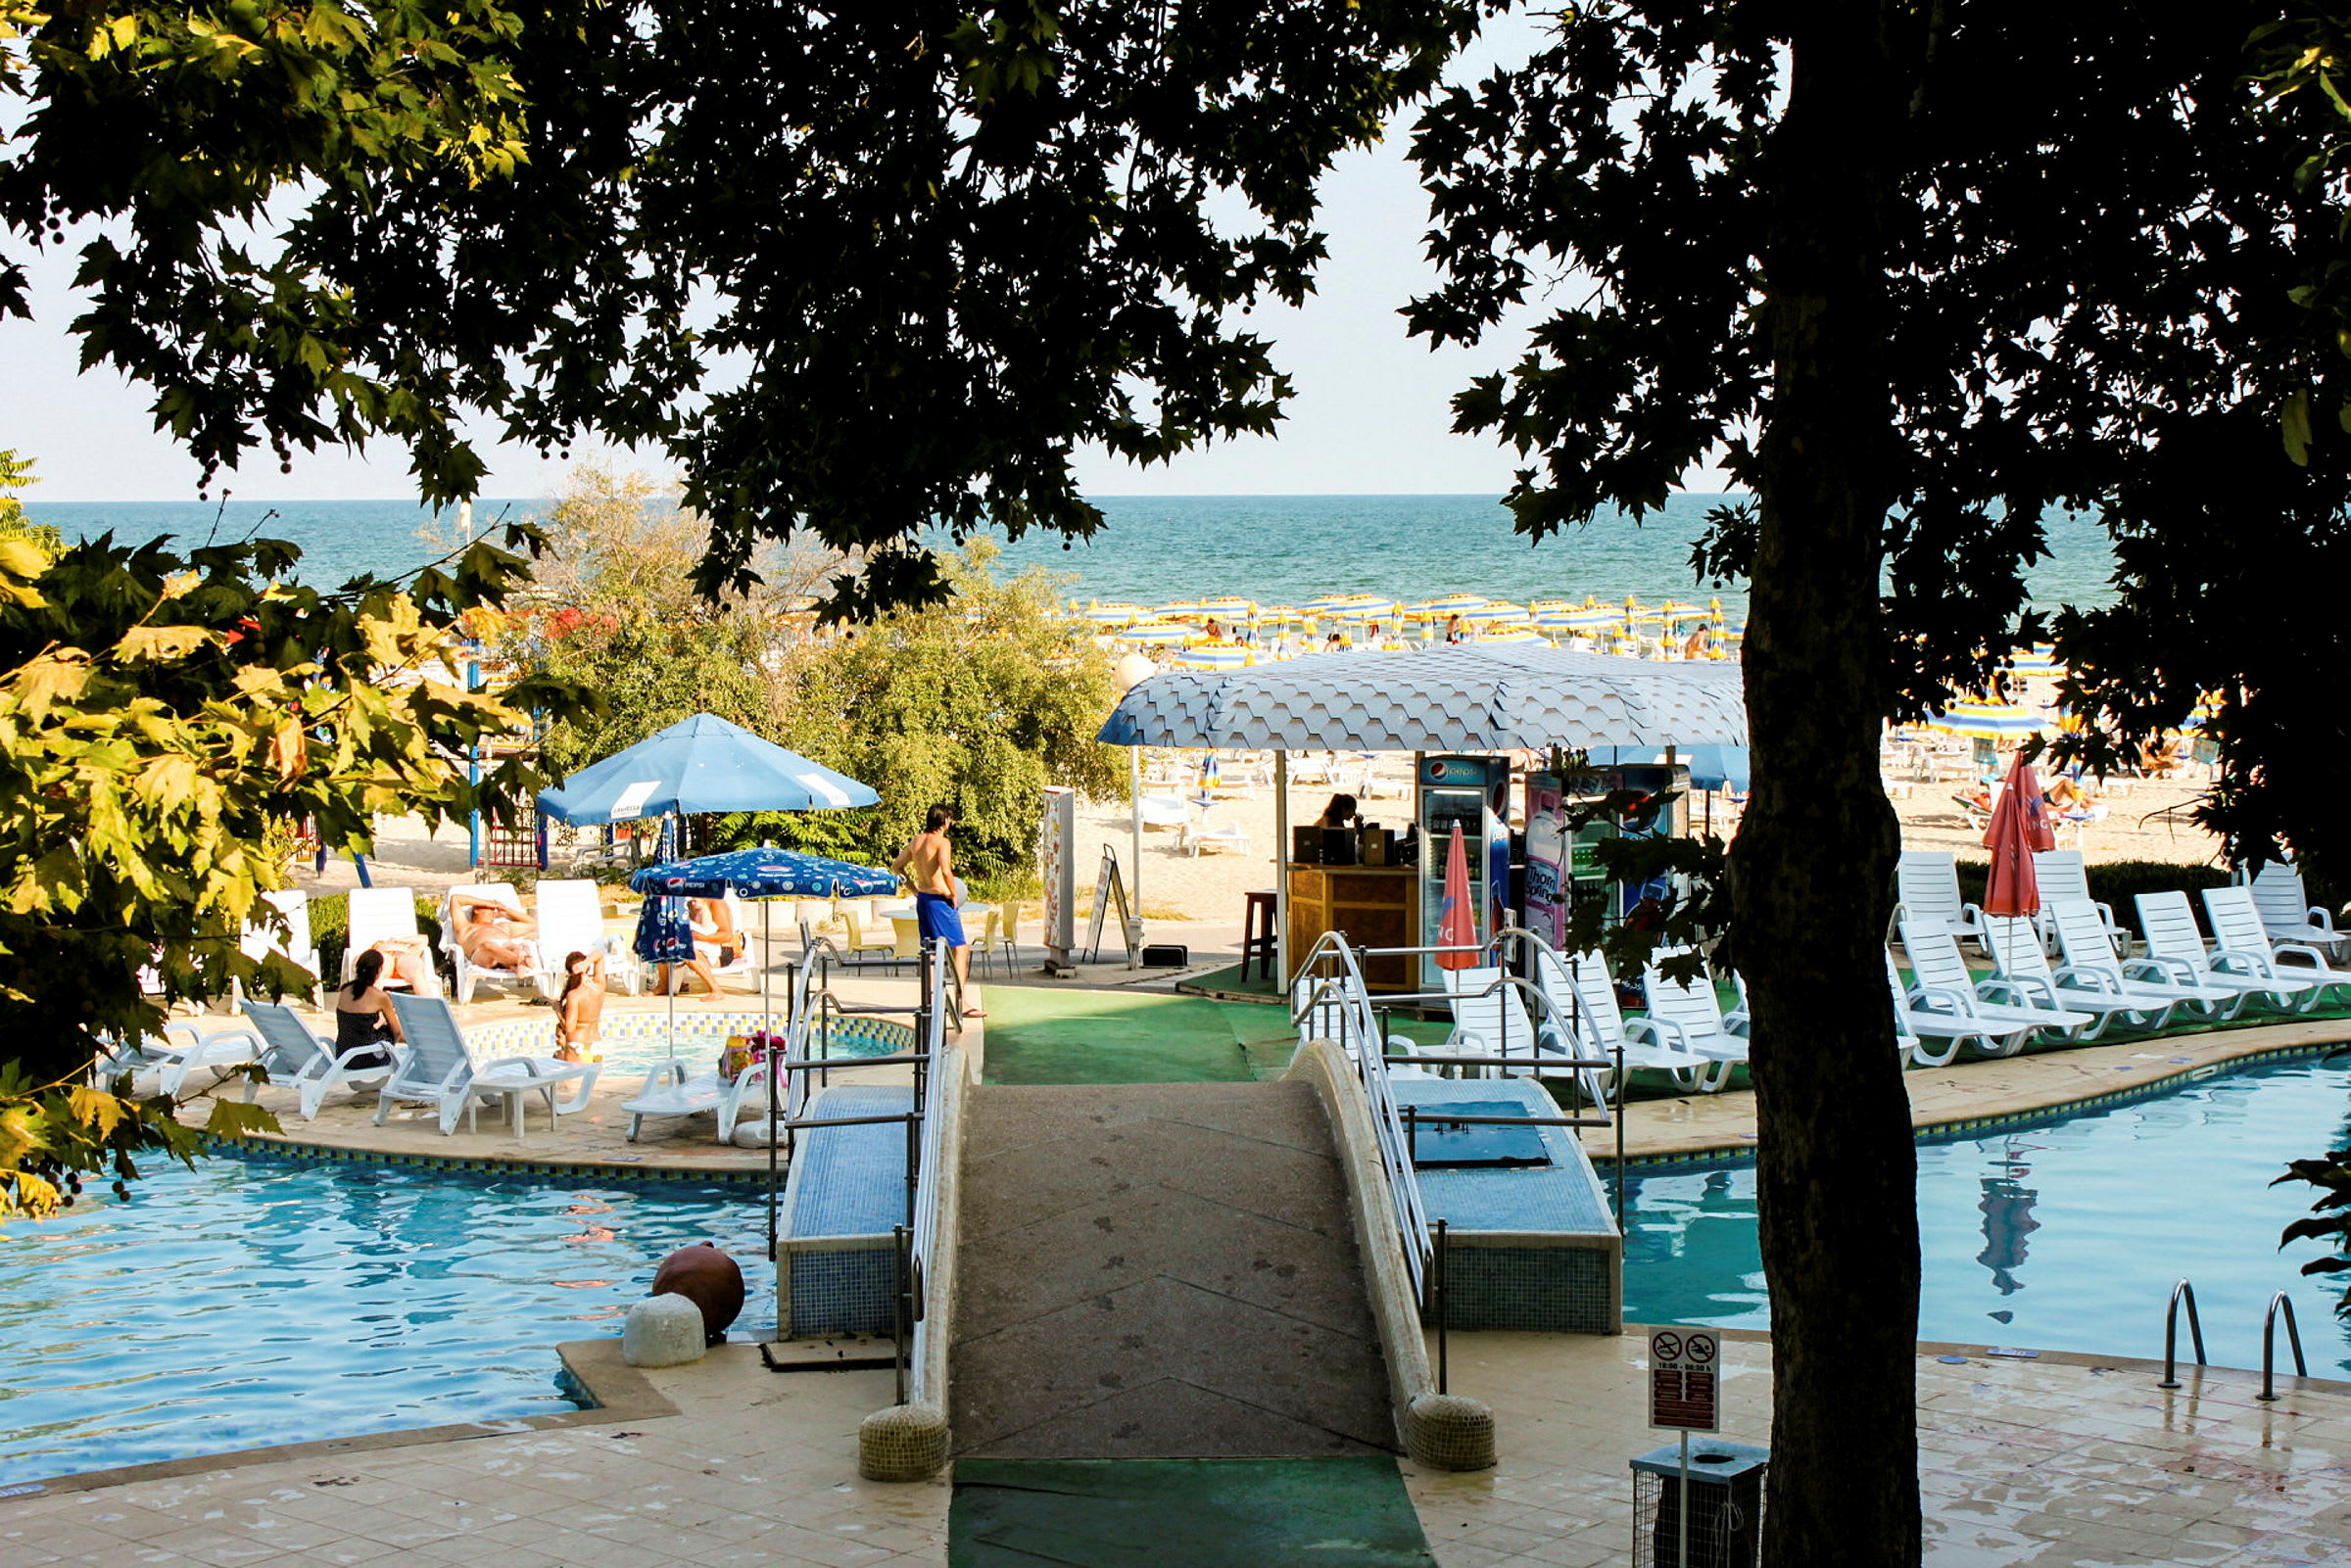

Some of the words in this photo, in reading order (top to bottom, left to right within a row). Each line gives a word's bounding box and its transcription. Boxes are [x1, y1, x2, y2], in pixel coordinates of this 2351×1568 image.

[1447, 767, 1477, 777] pepsi
[1529, 866, 1556, 890] Thorn
[1526, 881, 1553, 906] Spring
